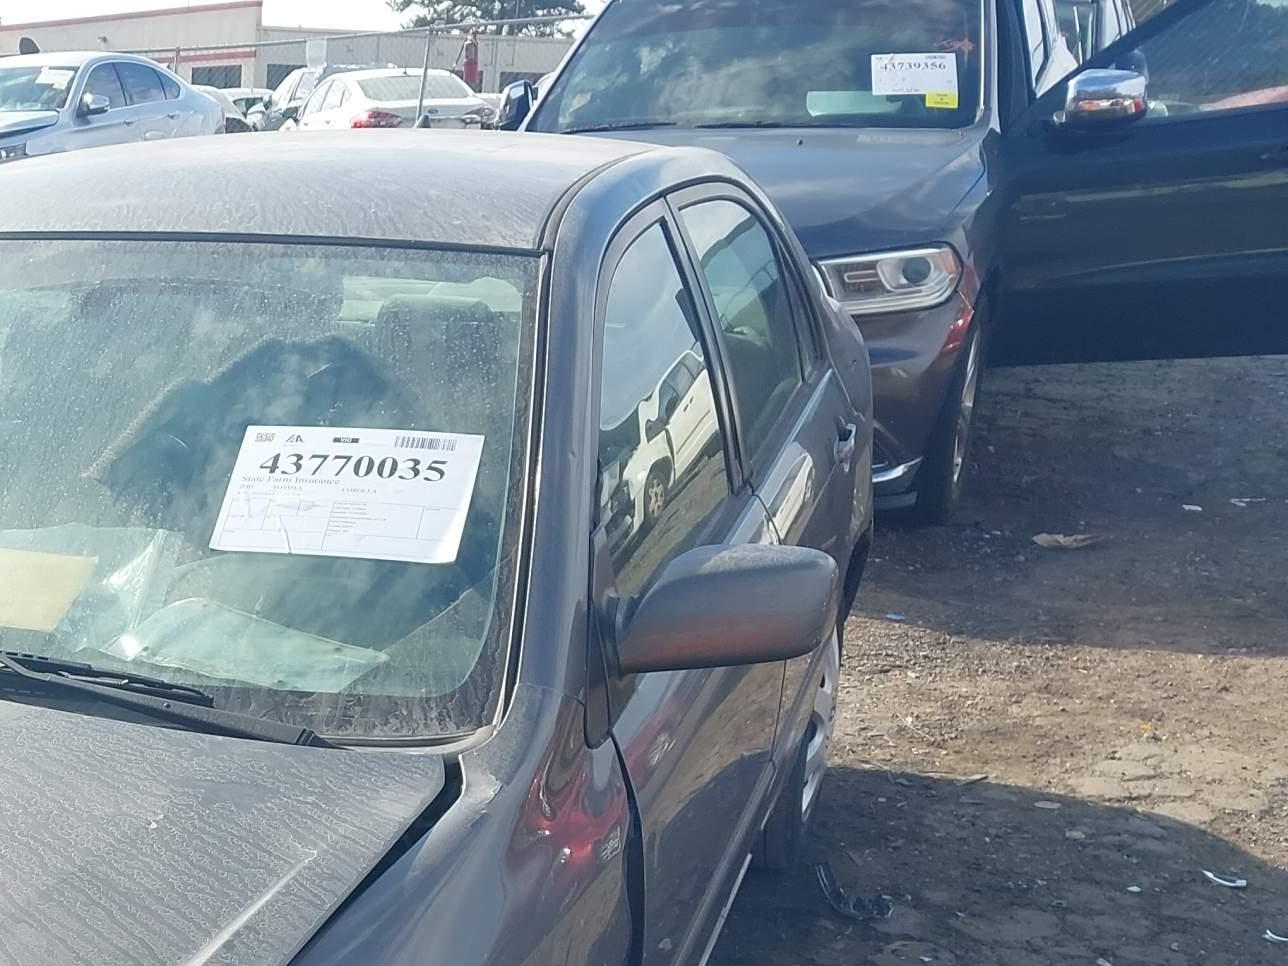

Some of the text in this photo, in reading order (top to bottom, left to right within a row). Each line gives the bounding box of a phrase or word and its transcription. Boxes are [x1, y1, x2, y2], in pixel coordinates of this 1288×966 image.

[259, 453, 449, 482] 43770035
[241, 475, 341, 485] State Farm Insurance
